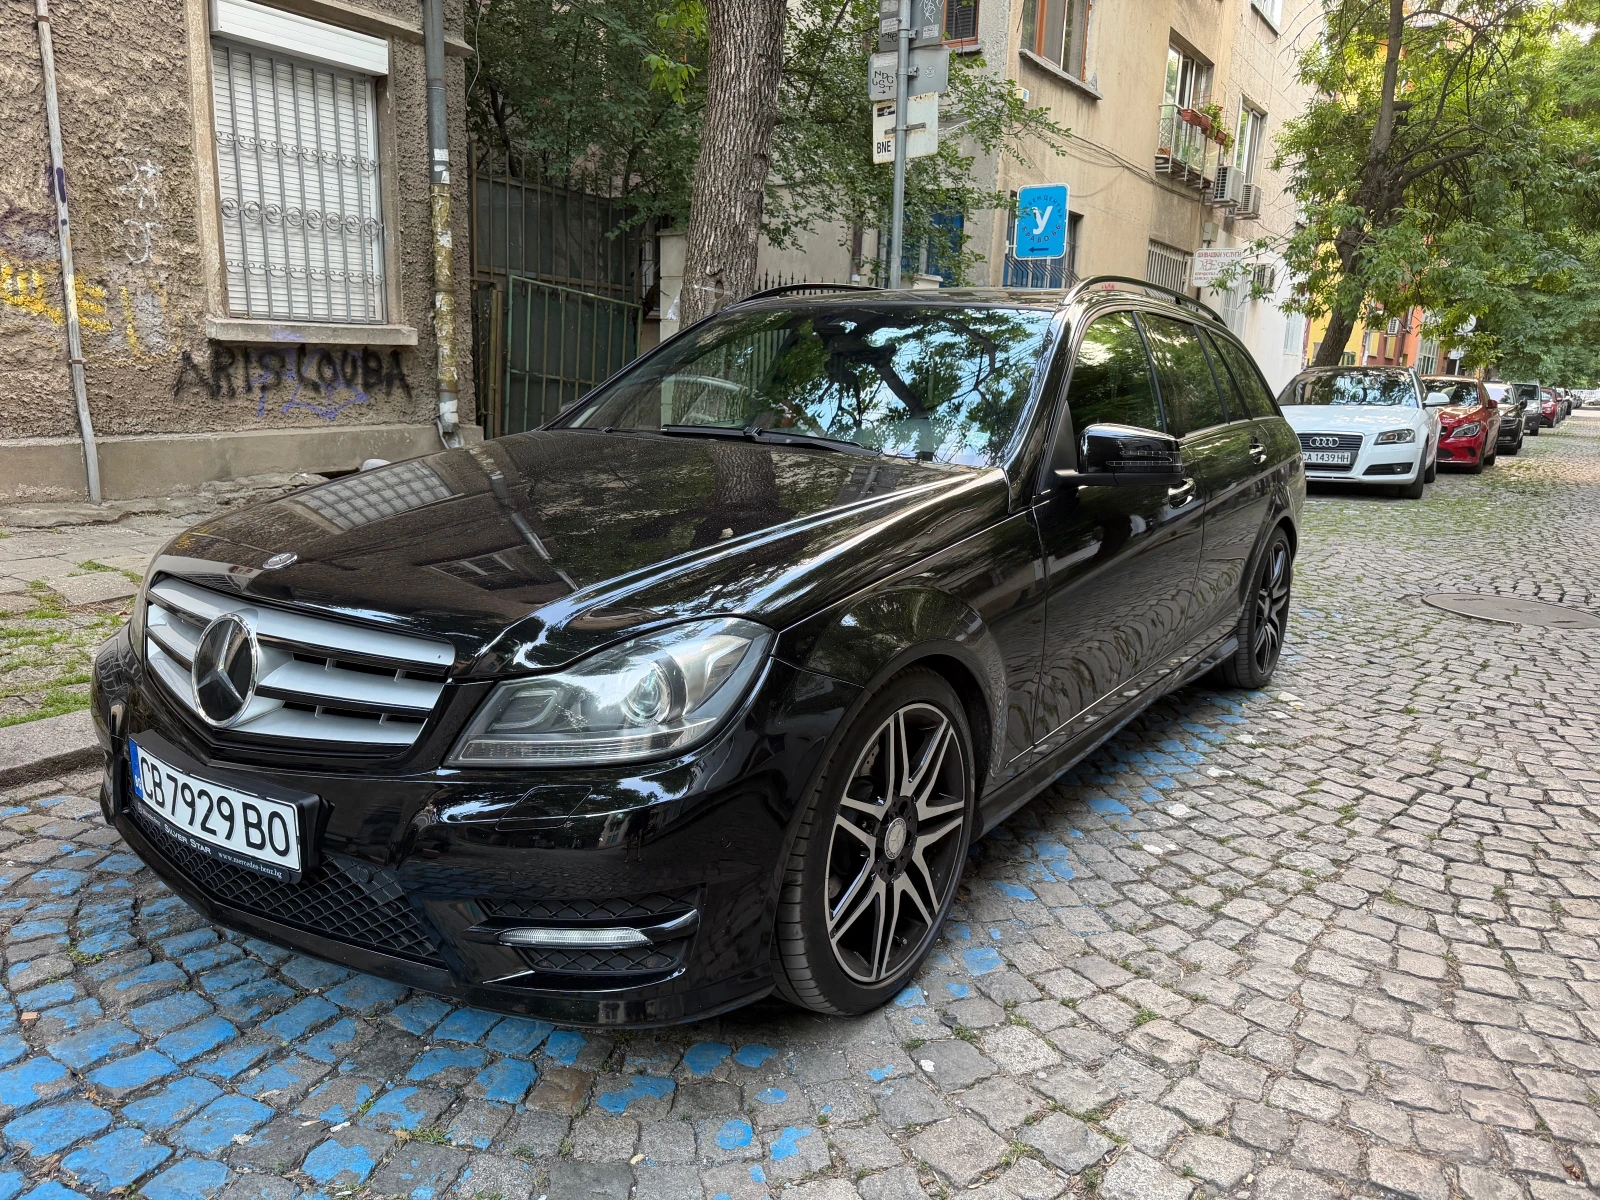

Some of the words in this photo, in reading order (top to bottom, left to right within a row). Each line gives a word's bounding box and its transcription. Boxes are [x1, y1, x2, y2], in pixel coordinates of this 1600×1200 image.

[877, 141, 892, 154] BNE
[1315, 453, 1336, 462] 1439
[1337, 454, 1349, 462] HH
[166, 773, 235, 841] 7929
[218, 852, 282, 879] www.mercedes-benz.bg
